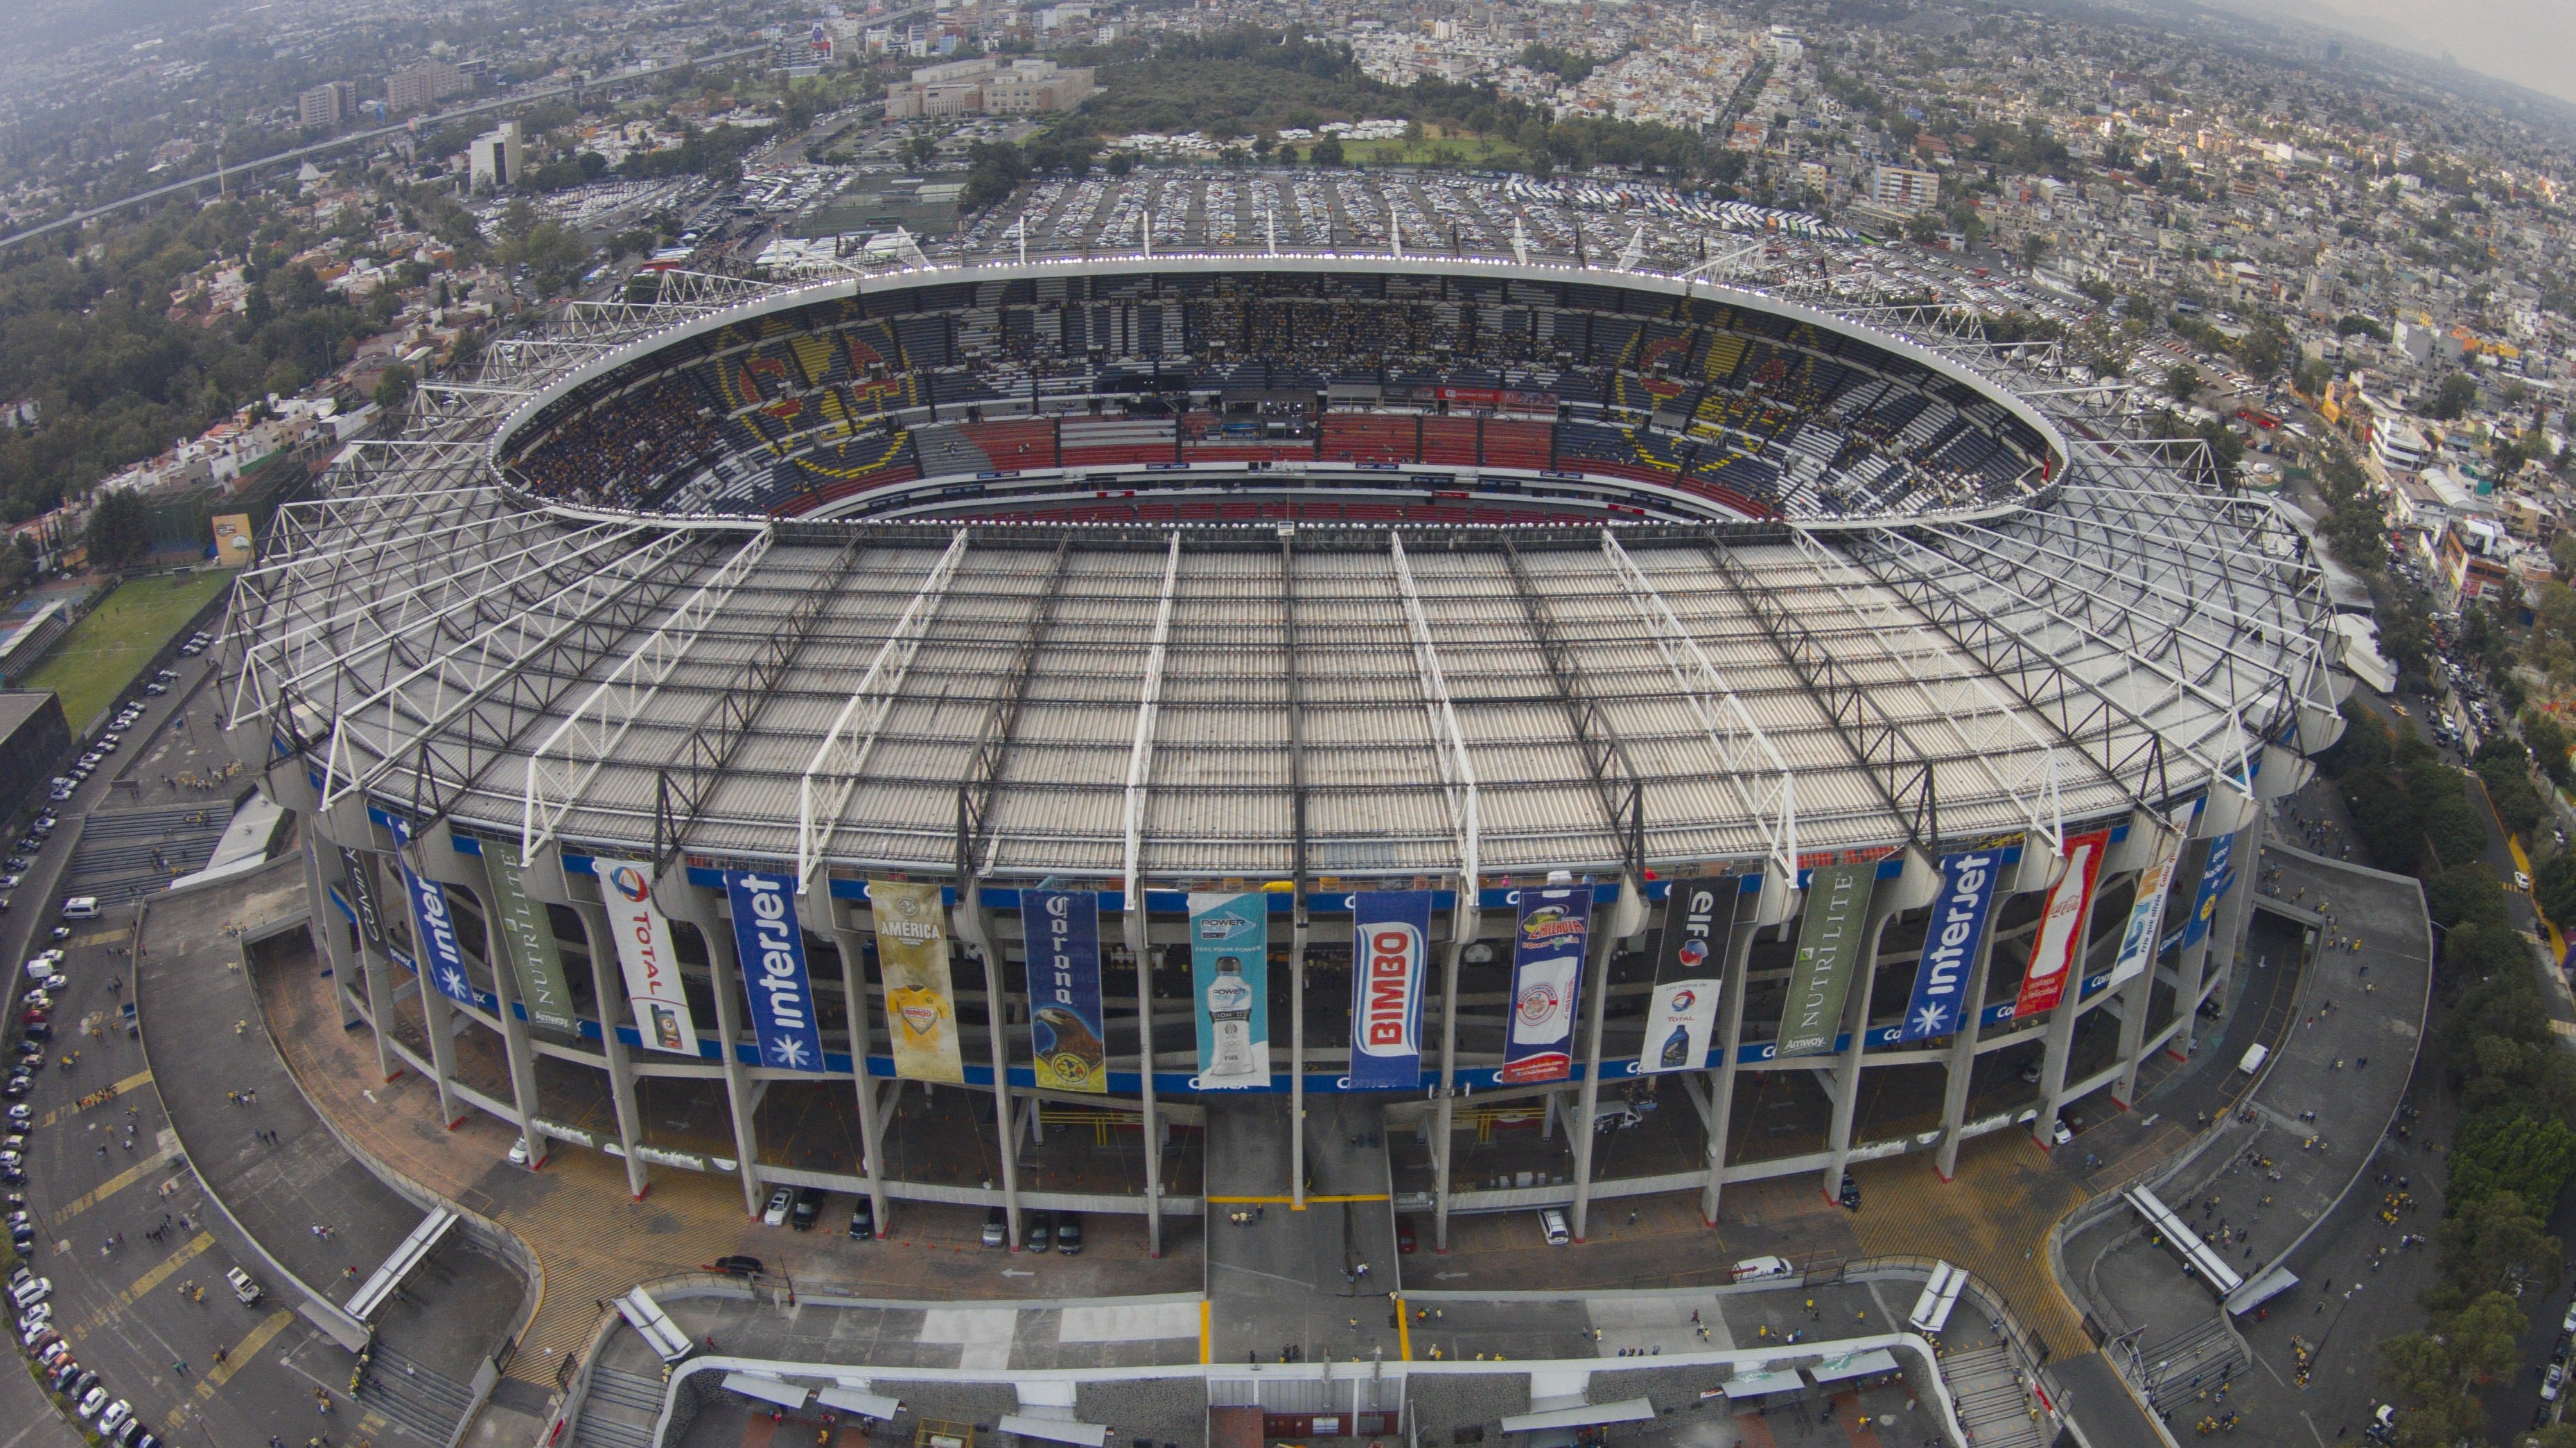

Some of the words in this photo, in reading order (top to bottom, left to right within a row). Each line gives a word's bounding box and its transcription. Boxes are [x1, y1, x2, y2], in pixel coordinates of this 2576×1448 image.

[2159, 865, 2171, 888] Calor
[501, 850, 554, 1006] NUTRILITE
[631, 911, 663, 996] TOTAL
[881, 919, 941, 939] AMÉRICA
[1045, 895, 1074, 1005] Corona
[1801, 874, 1852, 1028] NUTRILITE
[1369, 931, 1408, 1045] BIMBO
[1784, 1036, 1825, 1050] Amway
